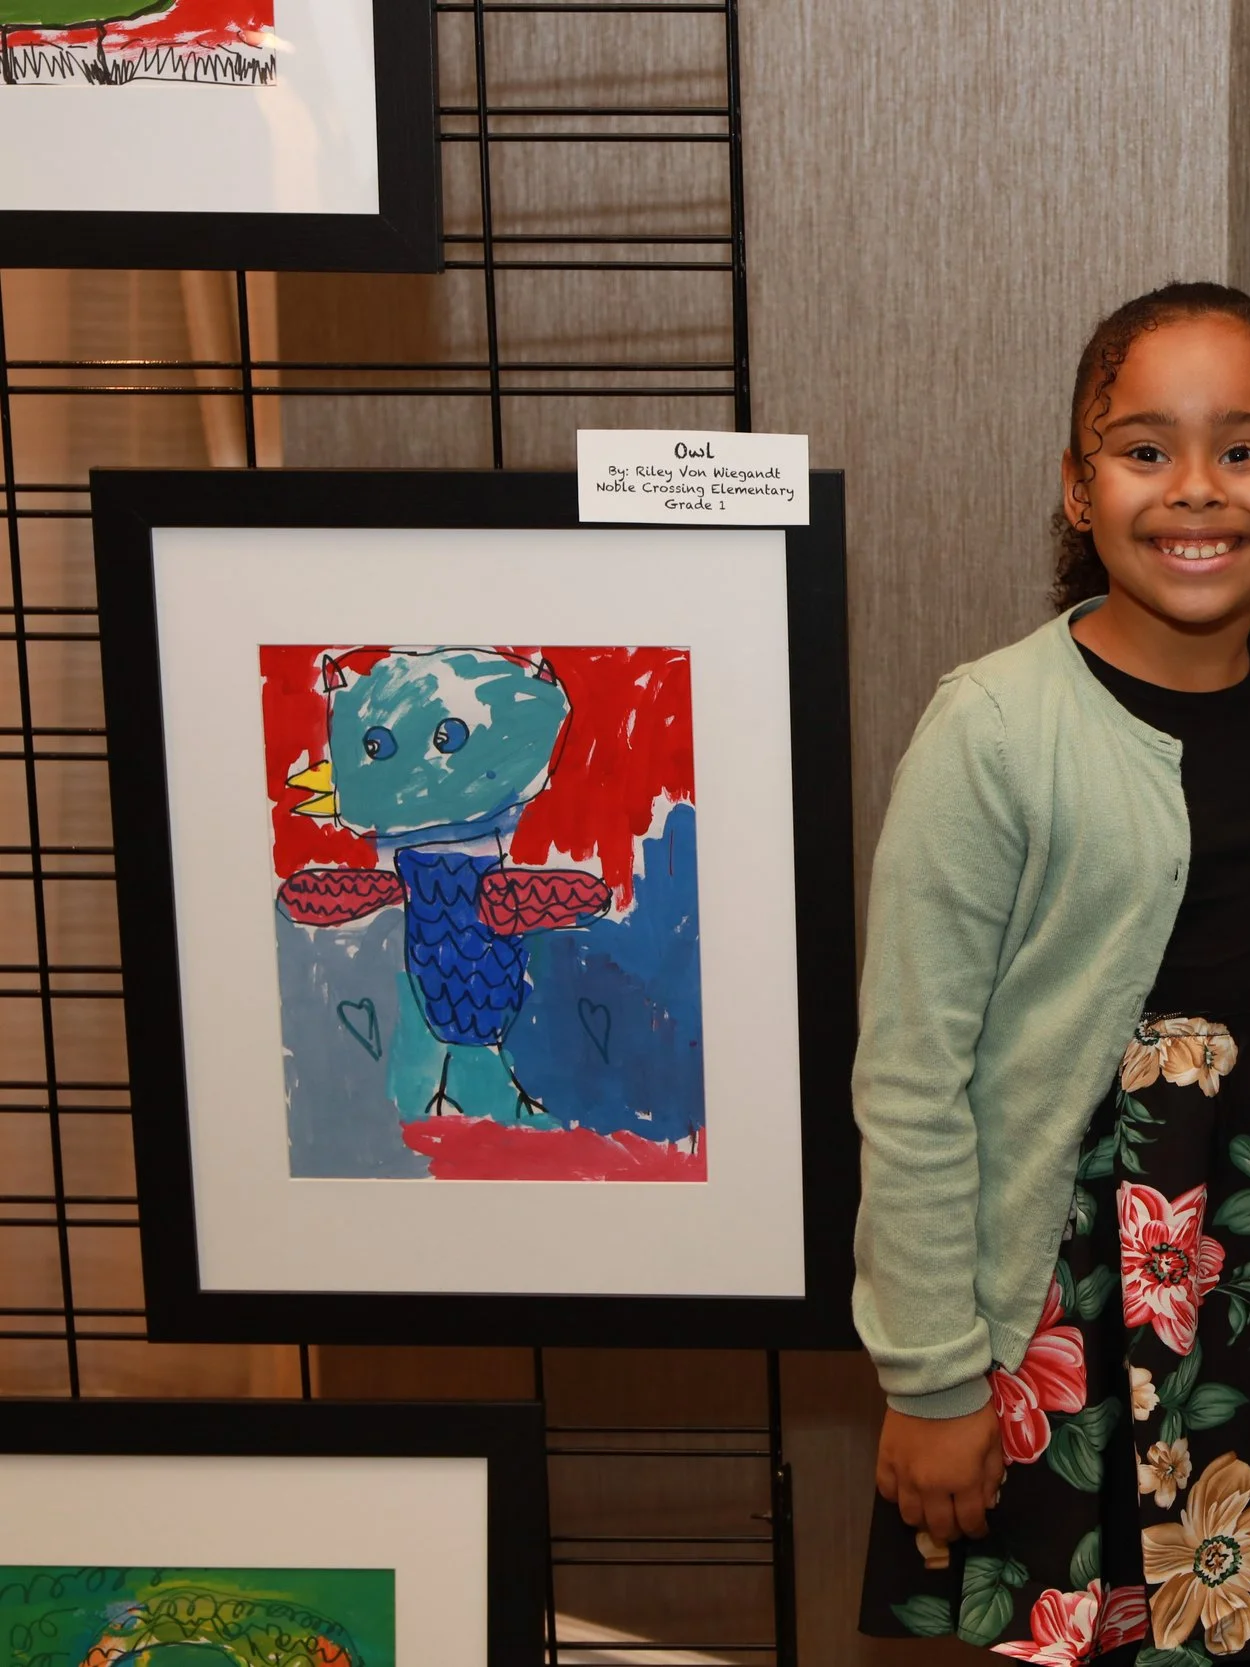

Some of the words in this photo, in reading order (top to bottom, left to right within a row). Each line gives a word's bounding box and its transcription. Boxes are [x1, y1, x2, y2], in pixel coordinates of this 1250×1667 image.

[674, 442, 715, 459] Owl
[608, 466, 629, 481] By:
[636, 466, 672, 482] Riley
[679, 466, 706, 477] Von
[714, 468, 780, 482] Wiegandt
[597, 480, 635, 493] Noble
[642, 483, 704, 497] Crossing
[712, 484, 794, 501] Elementary
[665, 499, 712, 510] Grade
[720, 501, 726, 510] 1
